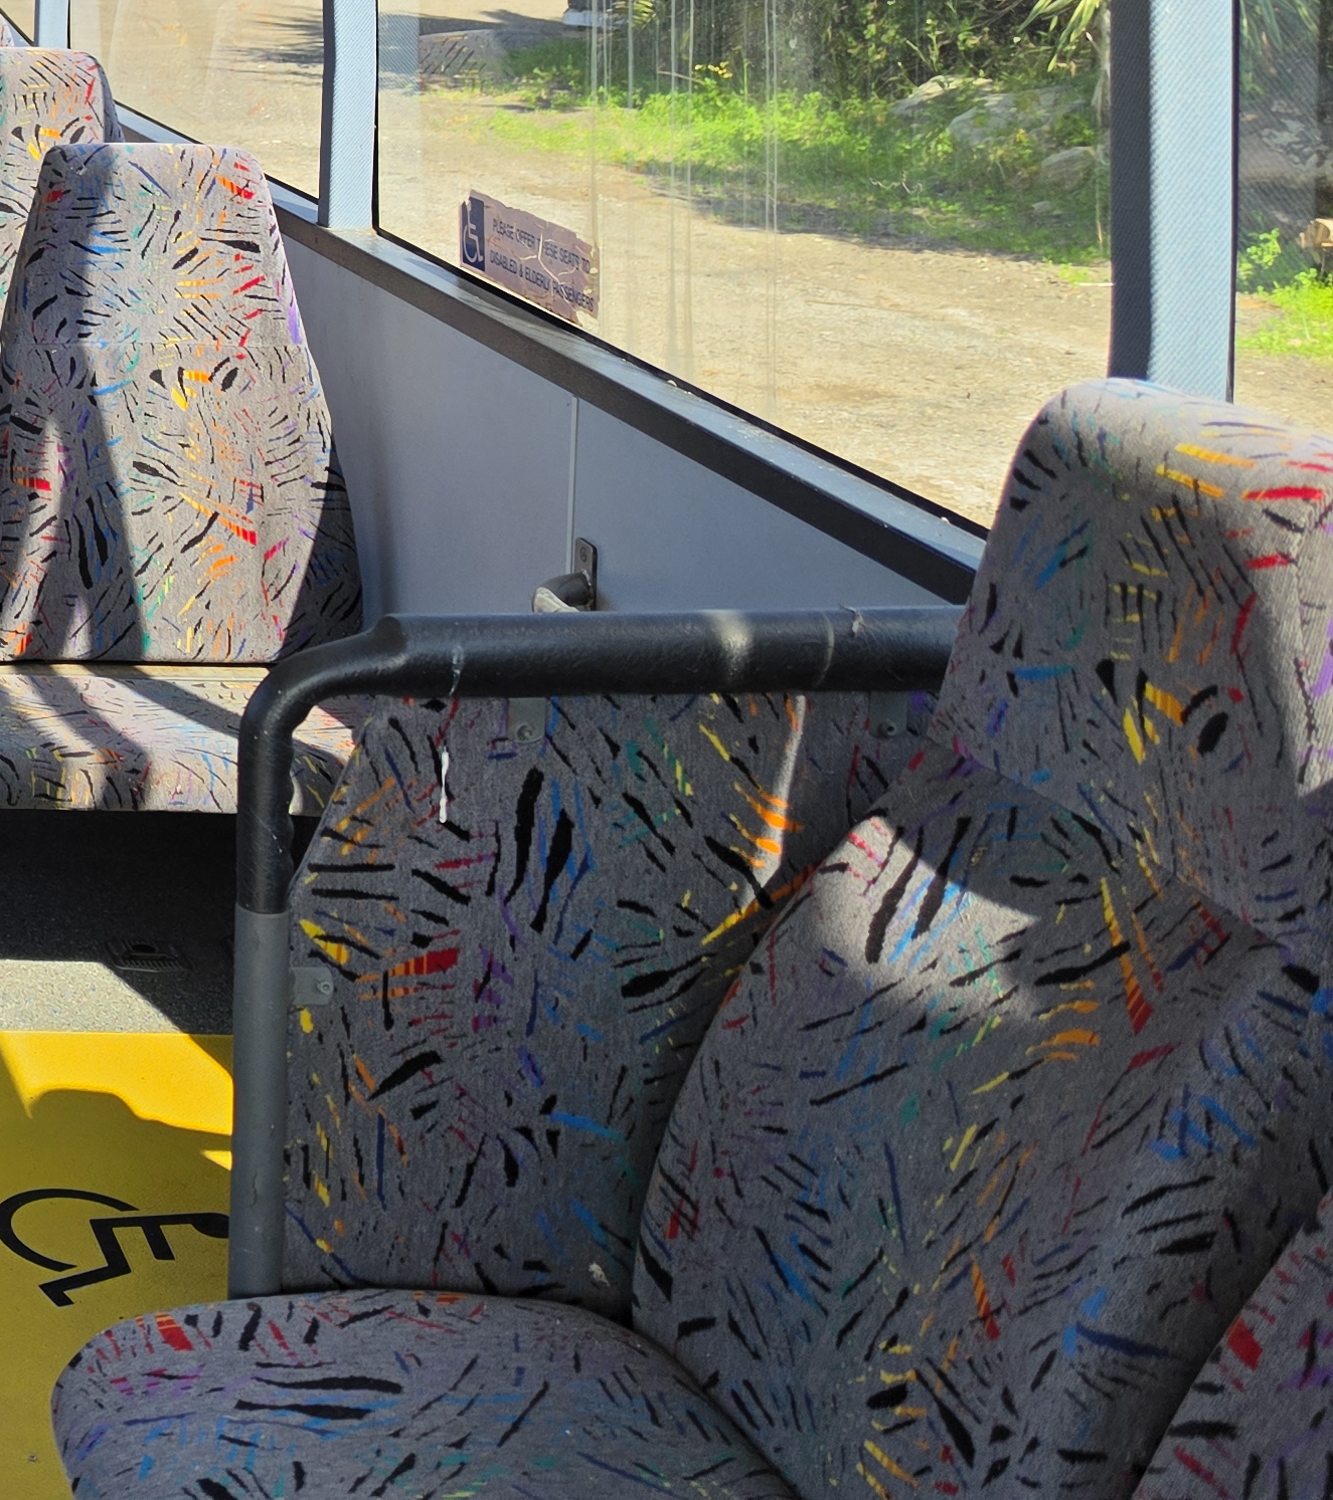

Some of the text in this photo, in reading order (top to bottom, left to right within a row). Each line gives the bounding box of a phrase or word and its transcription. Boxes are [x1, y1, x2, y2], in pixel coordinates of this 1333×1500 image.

[493, 218, 515, 240] PLEASE
[490, 249, 517, 275] DISABLED
[524, 266, 550, 291] ELDERLY
